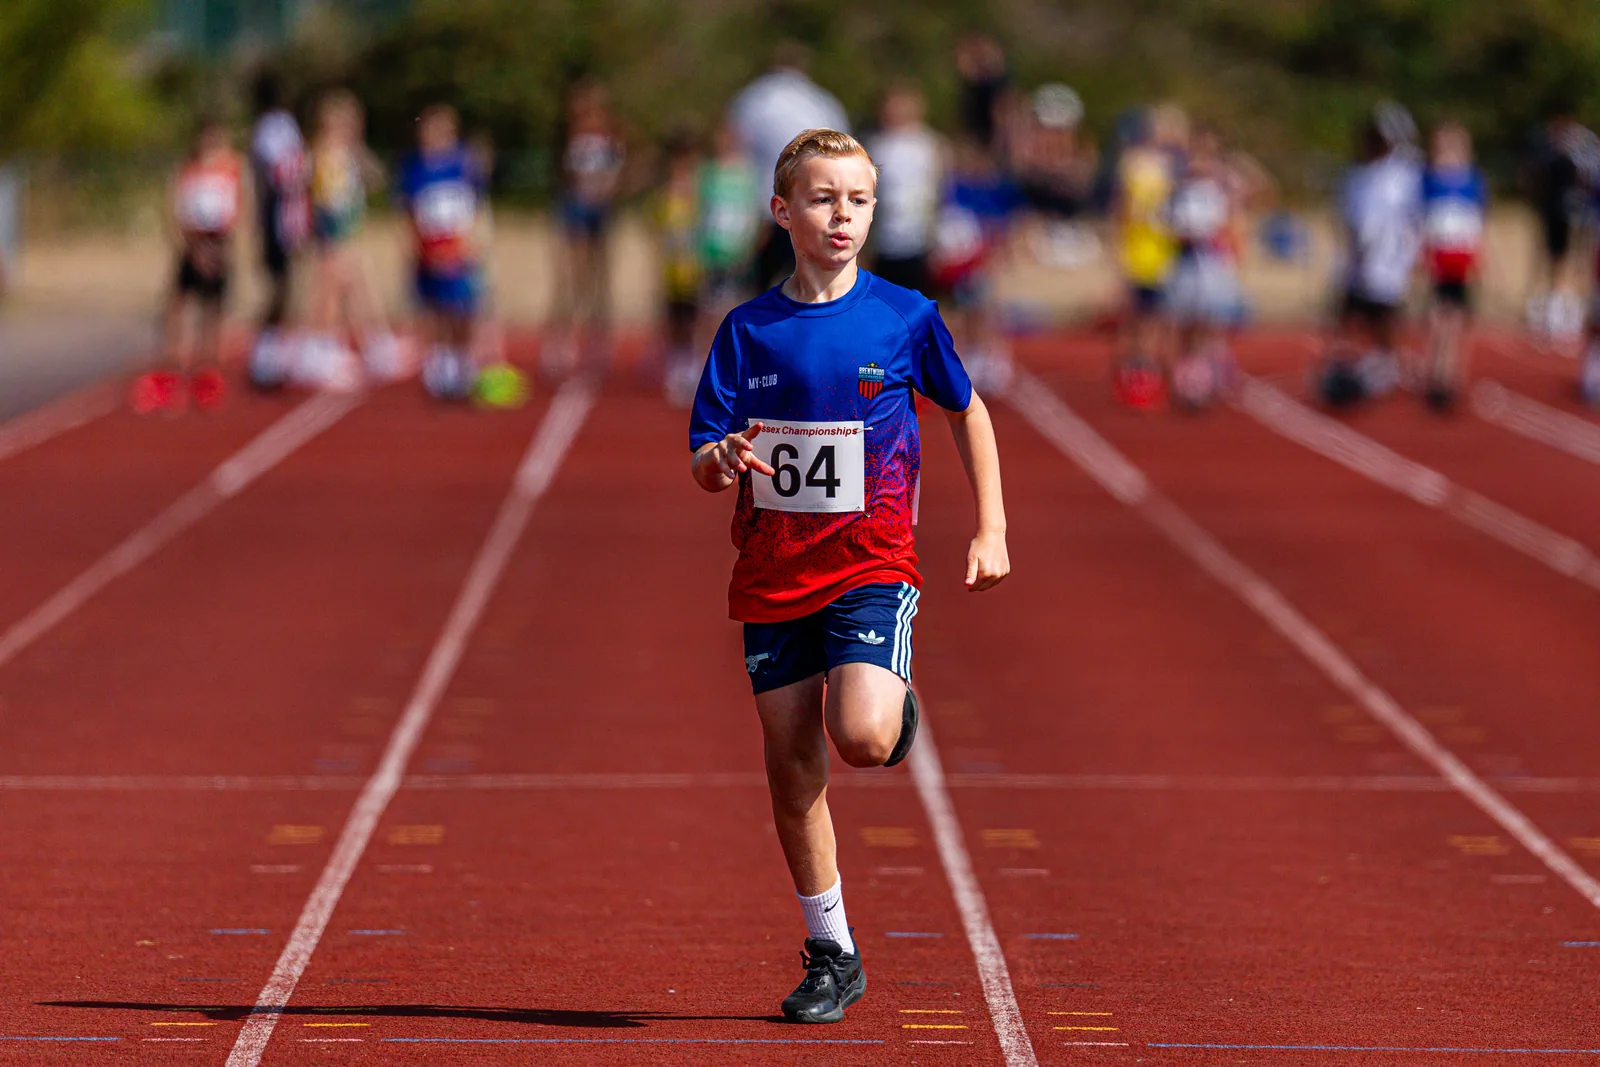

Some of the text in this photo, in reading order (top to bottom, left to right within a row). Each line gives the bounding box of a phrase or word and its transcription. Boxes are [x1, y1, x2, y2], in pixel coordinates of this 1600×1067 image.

[859, 366, 885, 376] BRENTWOOD
[760, 425, 858, 437] ssex Championships
[770, 443, 841, 498] 64
